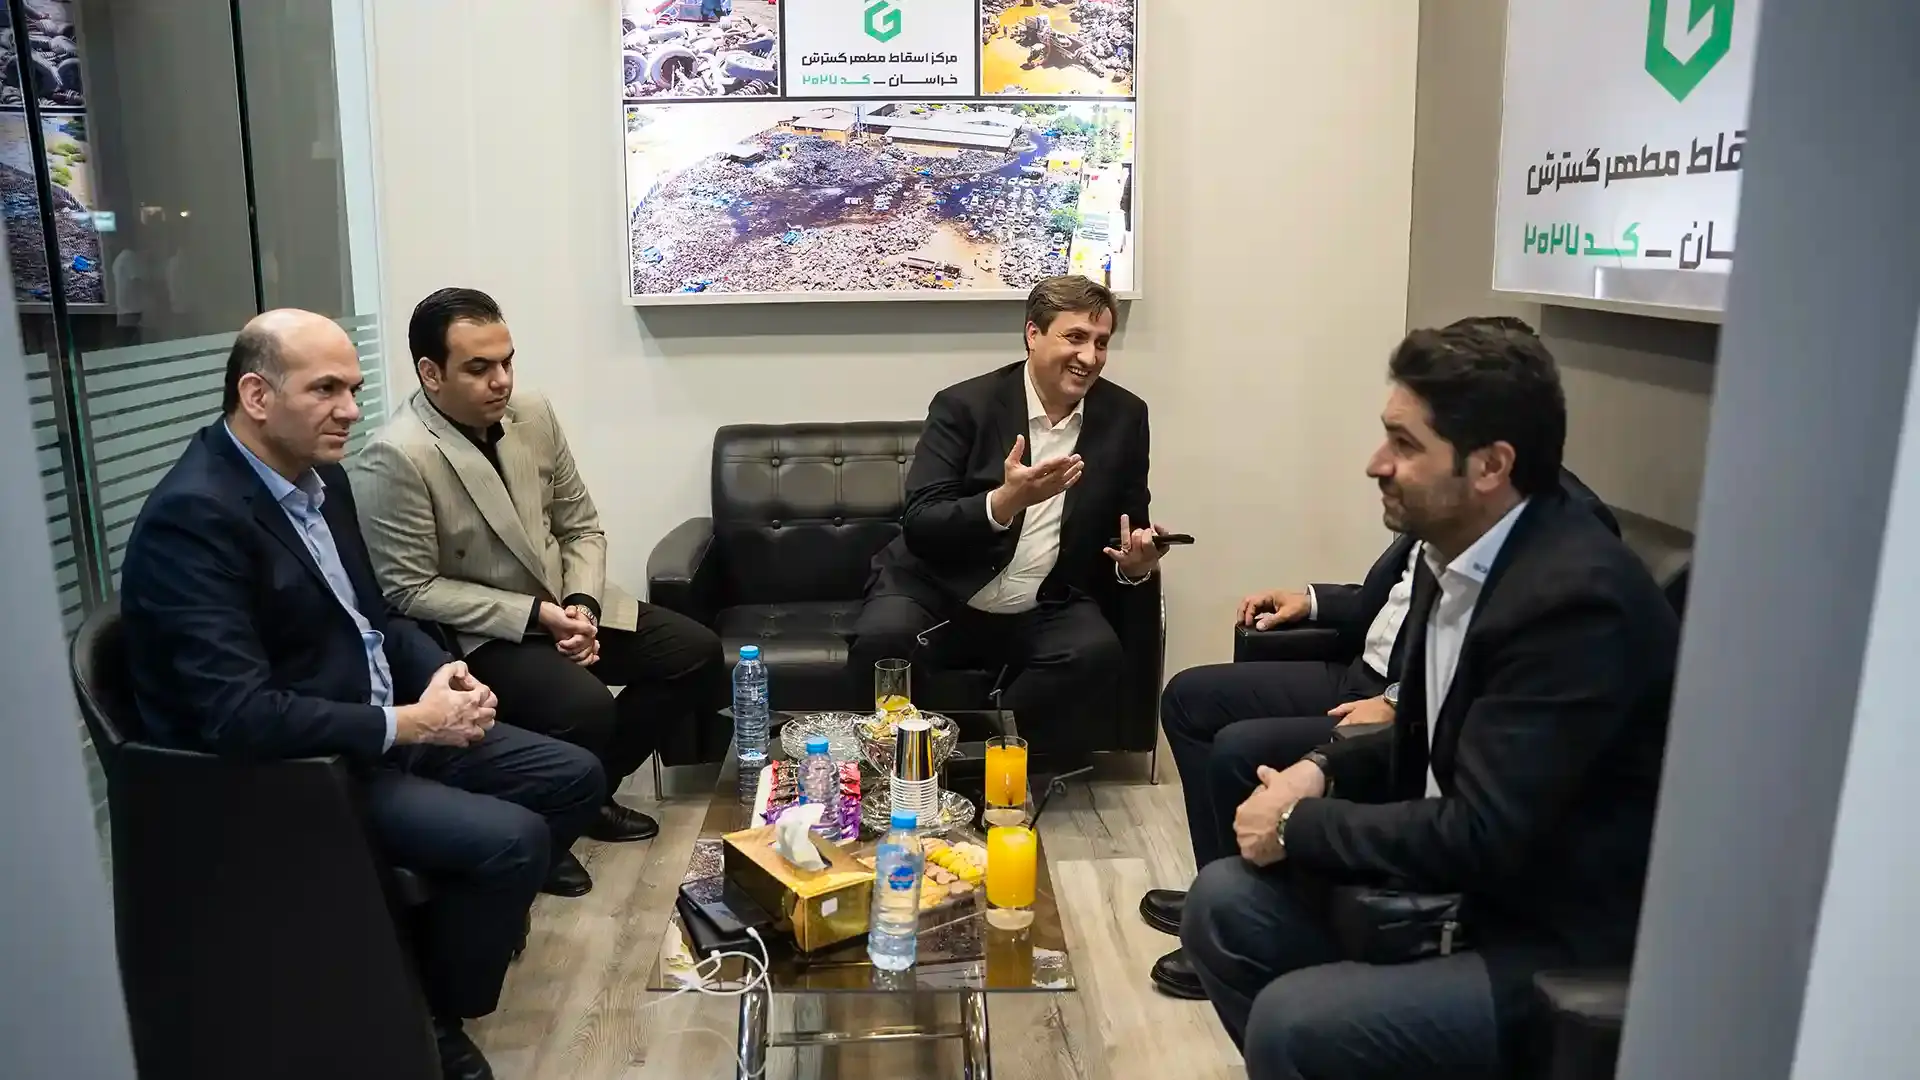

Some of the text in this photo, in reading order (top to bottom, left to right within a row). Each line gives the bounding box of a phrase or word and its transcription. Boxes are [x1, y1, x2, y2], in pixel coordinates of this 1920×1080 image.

[801, 52, 958, 66] مرکز اسقاط مطهر گسترش
[840, 73, 871, 85] کد
[888, 74, 958, 87] خراسان
[1526, 147, 1600, 195] گسترش
[1605, 143, 1680, 189] مطهر
[1583, 222, 1641, 258] کد
